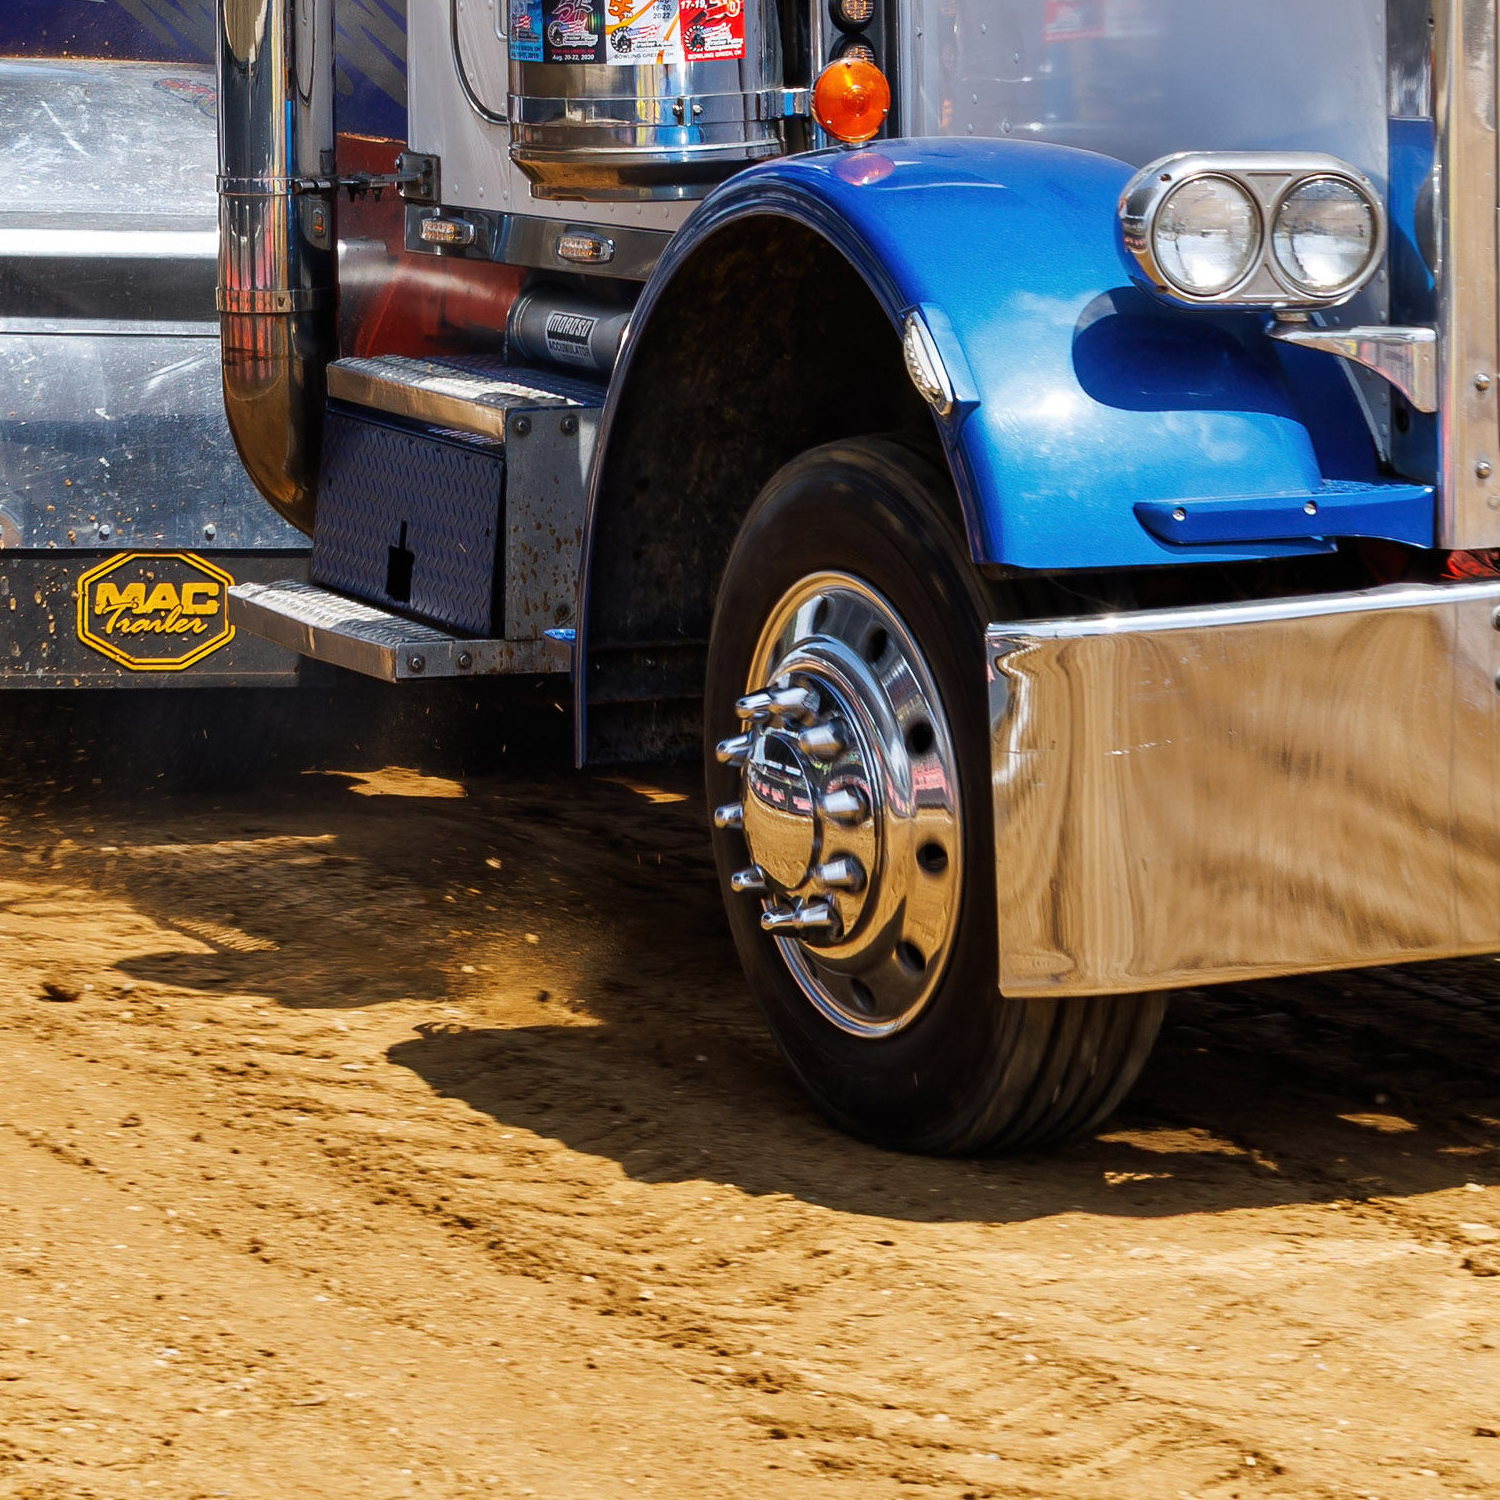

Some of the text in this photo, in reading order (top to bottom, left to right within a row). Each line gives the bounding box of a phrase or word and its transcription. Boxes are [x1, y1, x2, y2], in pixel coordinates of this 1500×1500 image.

[681, 0, 708, 9] 17-19,
[548, 314, 594, 338] MOROSO
[548, 339, 591, 357] ACCUMULATOR
[94, 582, 220, 616] MAC
[101, 600, 209, 635] Trailer
